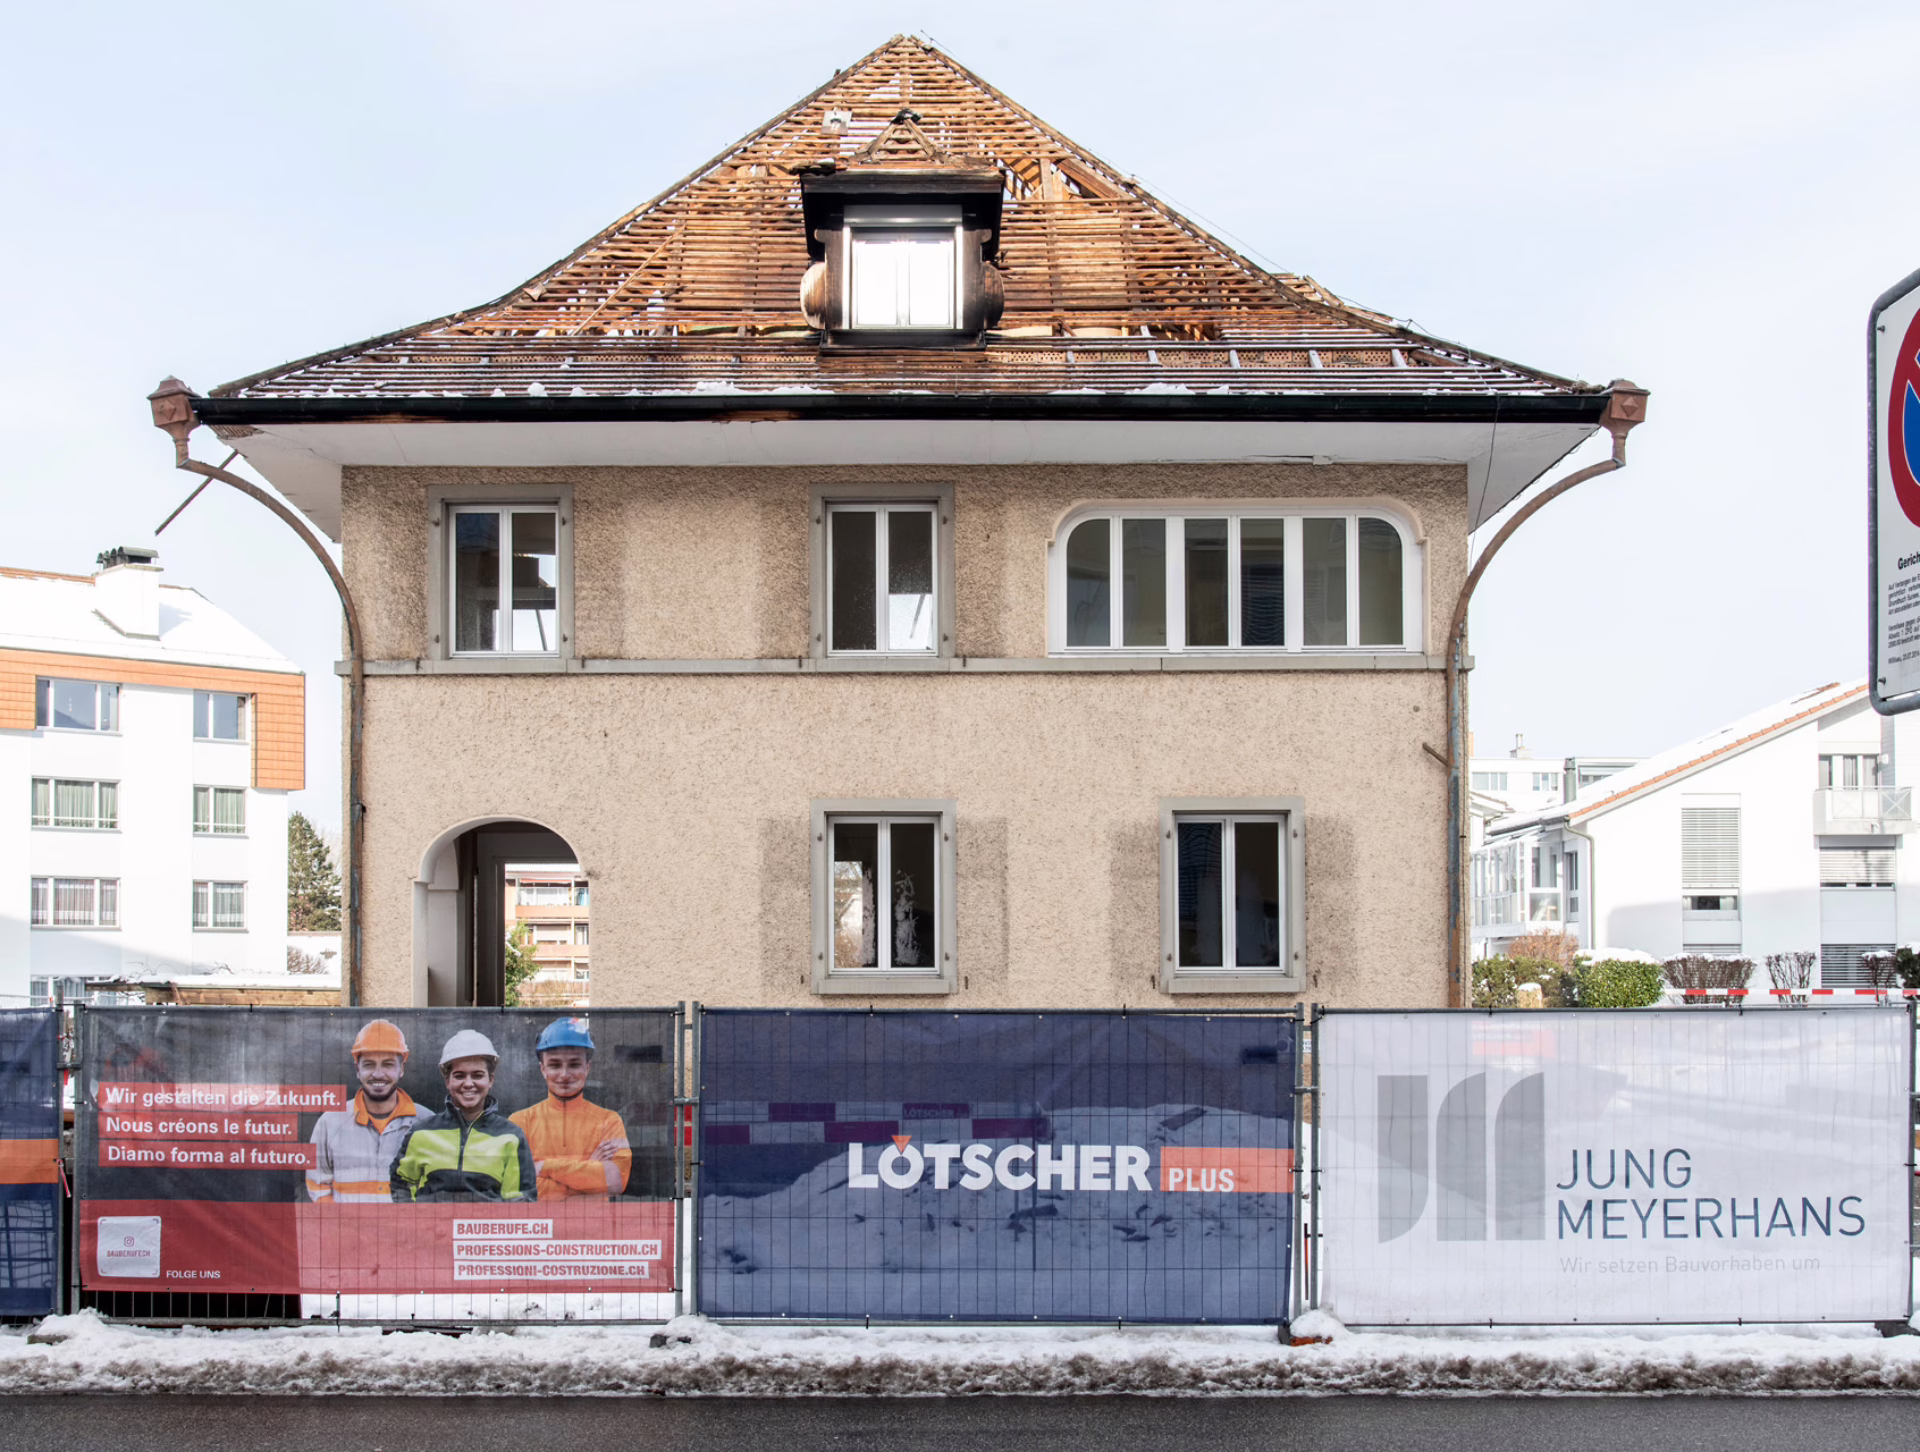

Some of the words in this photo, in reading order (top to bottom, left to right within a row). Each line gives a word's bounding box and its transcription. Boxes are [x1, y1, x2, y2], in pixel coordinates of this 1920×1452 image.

[105, 1087, 137, 1104] Wir
[142, 1089, 226, 1107] gestalten
[231, 1089, 259, 1106] die
[264, 1090, 341, 1107] Zukunft.
[105, 1116, 154, 1133] Nous
[158, 1117, 219, 1134] créons
[224, 1118, 239, 1134] le
[245, 1118, 292, 1135] futur.
[108, 1146, 166, 1161] Diamo
[170, 1146, 224, 1163] forma
[230, 1147, 245, 1163] al
[250, 1148, 311, 1164] futuro.
[1556, 1148, 1692, 1190] JUNG
[1168, 1168, 1235, 1192] PLUS
[1557, 1196, 1866, 1240] MEYERHANS
[456, 1223, 549, 1235] BAUBERUFE.CH
[456, 1244, 658, 1256] PROFESSIONS-CONSTRUCTION.CH
[458, 1265, 645, 1276] PROFESSIONI-COSTRUZIONE.CH
[1560, 1257, 1592, 1273] Wir
[1598, 1258, 1658, 1273] setzen
[1665, 1256, 1786, 1273] Bauvorhaben
[1792, 1258, 1821, 1271] um
[166, 1270, 197, 1279] FOLGE
[199, 1270, 221, 1279] UNS
